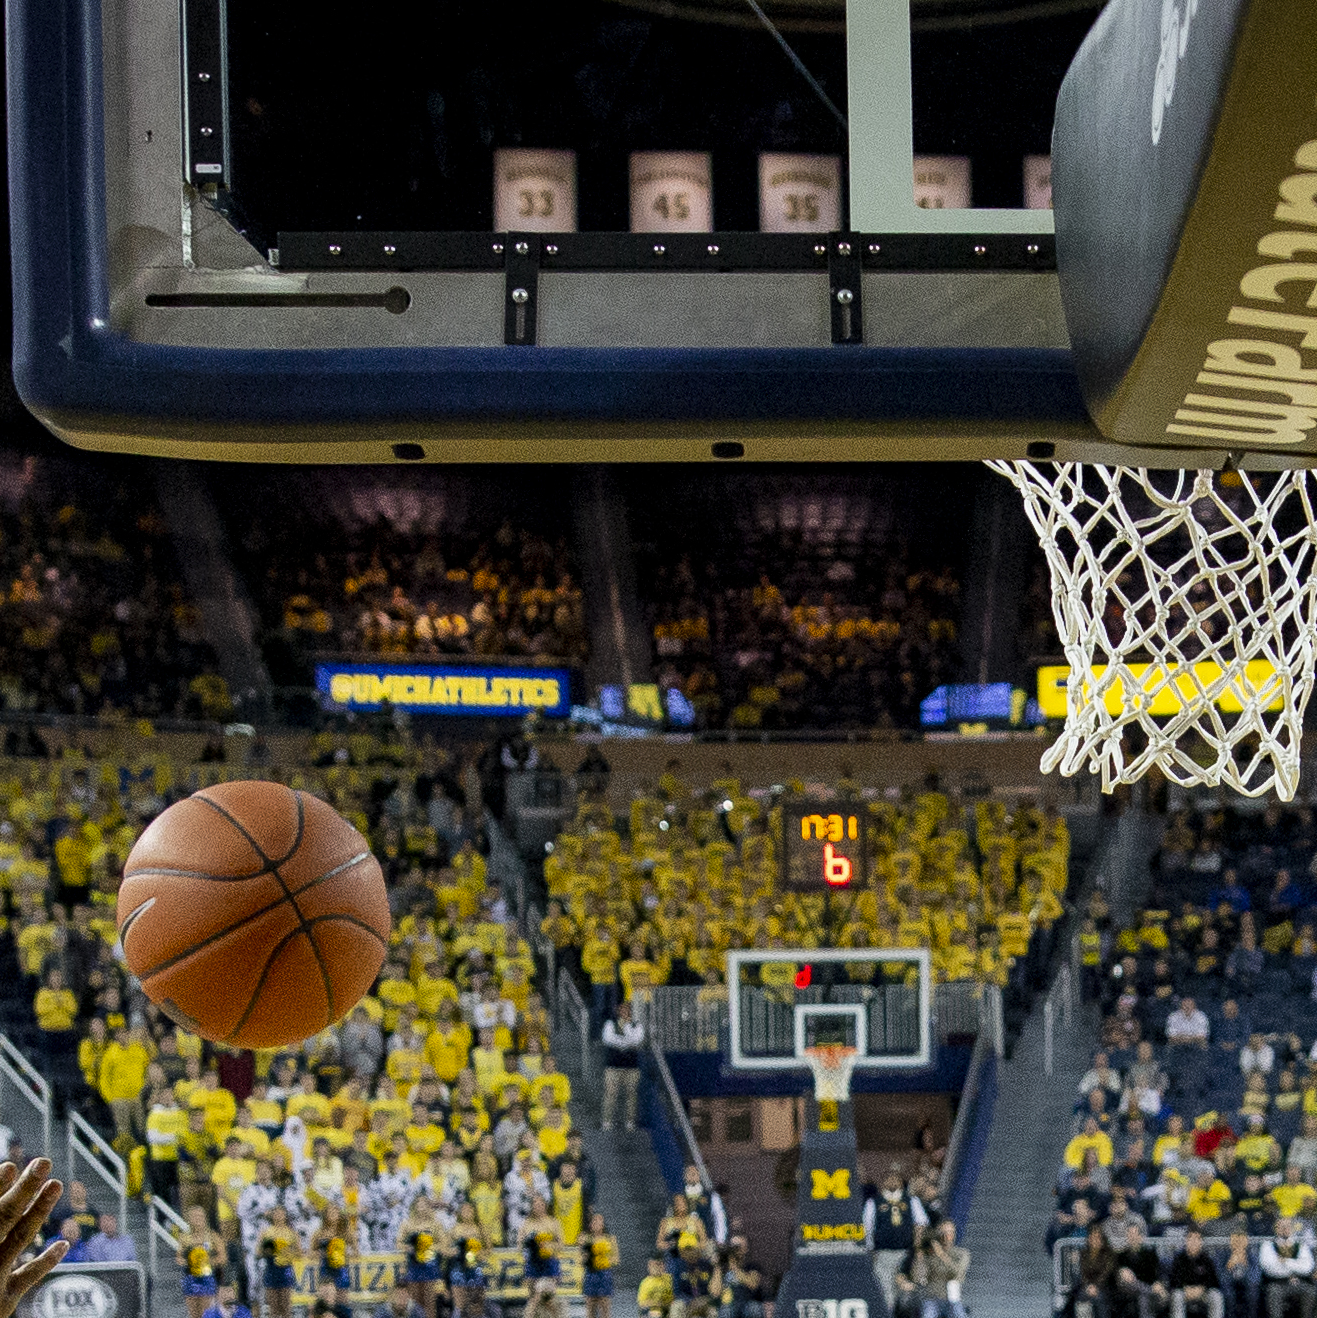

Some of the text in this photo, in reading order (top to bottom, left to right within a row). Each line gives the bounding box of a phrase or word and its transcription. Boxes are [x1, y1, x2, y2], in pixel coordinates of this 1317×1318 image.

[824, 843, 853, 886] 6
[810, 1168, 851, 1199] M
[51, 1289, 95, 1308] FOX
